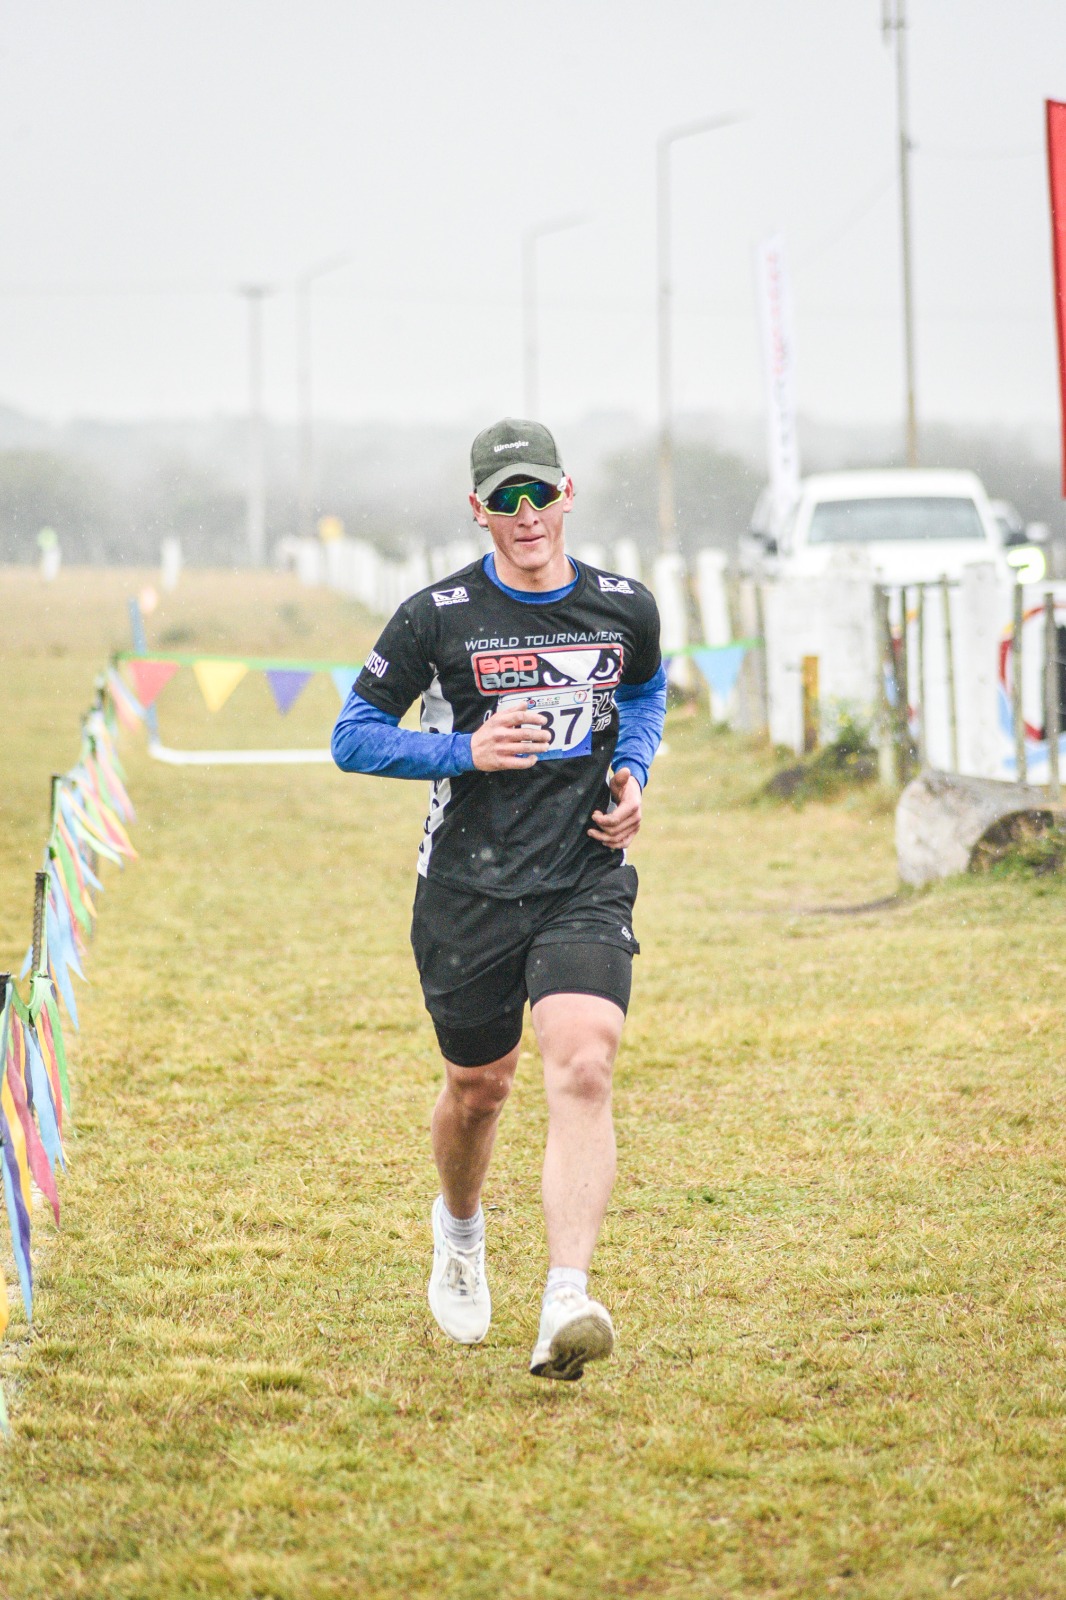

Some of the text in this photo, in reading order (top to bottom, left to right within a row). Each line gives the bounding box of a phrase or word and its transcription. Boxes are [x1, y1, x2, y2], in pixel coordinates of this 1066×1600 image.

[494, 440, 529, 453] Wrangler
[464, 631, 623, 651] WORLD TOURNAMENT
[478, 654, 538, 674] BAD
[480, 670, 539, 689] BOY
